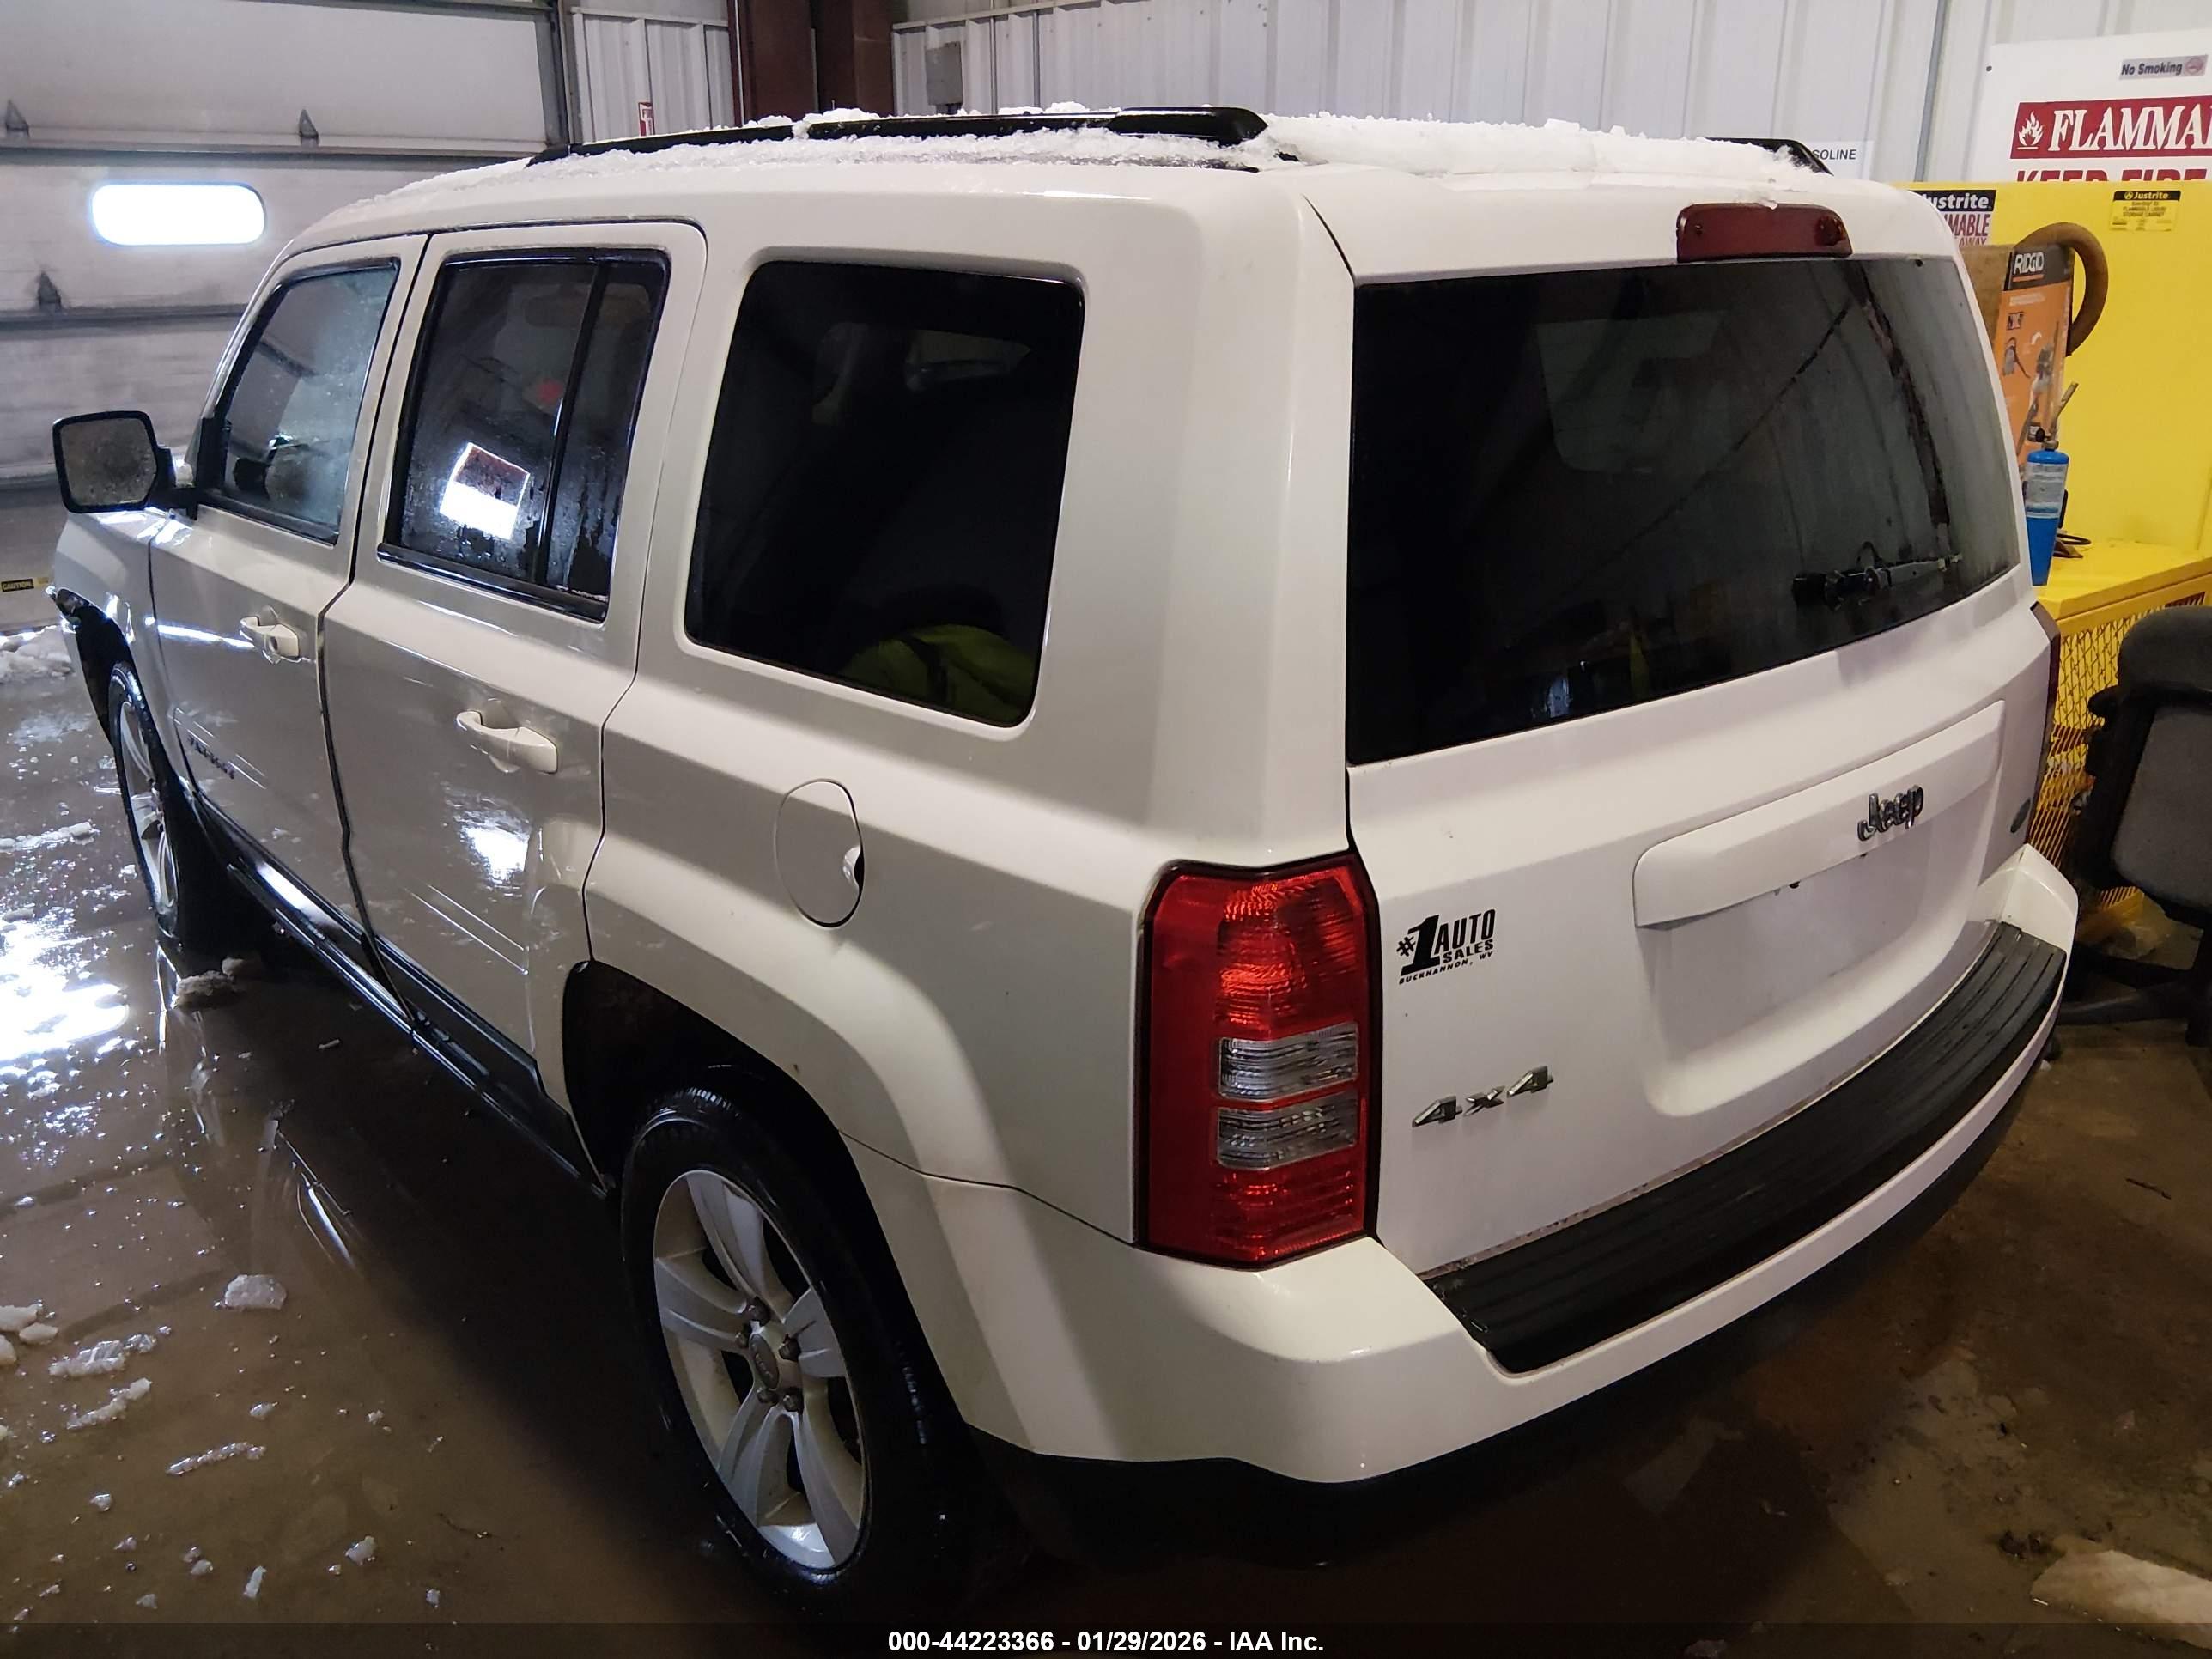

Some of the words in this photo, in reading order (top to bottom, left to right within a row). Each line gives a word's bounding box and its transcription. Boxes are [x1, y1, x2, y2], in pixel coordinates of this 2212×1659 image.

[2121, 64, 2136, 76] No
[2137, 62, 2183, 76] Smoking
[2048, 103, 2212, 151] FLAMMA
[2134, 191, 2169, 200] Justrite
[1944, 213, 1990, 236] MABLE
[2014, 252, 2044, 274] RIDGID
[1857, 785, 1924, 842] Jeep
[1434, 909, 1496, 955] AUTO
[1443, 939, 1494, 963] SALES
